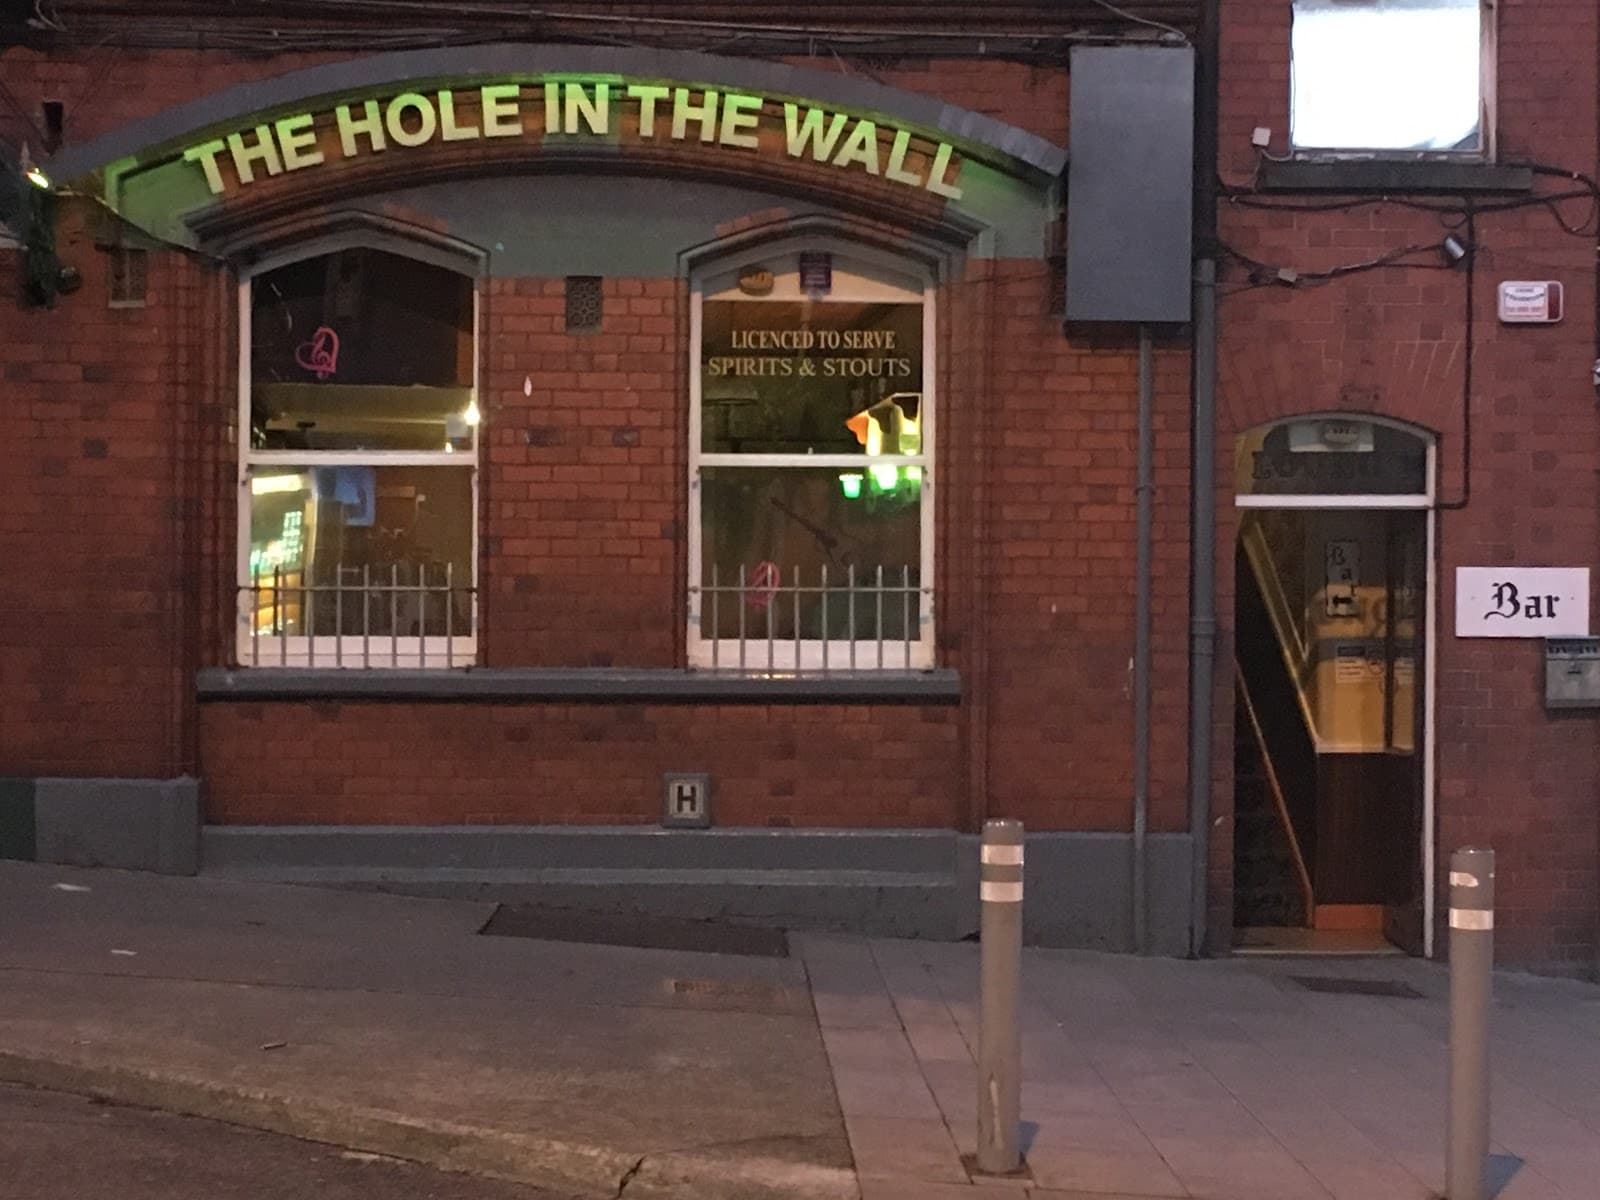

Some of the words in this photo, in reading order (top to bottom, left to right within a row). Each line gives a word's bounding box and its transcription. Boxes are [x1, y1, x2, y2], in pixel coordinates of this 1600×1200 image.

[183, 113, 324, 195] THE
[335, 84, 523, 158] HOLE
[543, 82, 611, 135] IN
[627, 85, 764, 148] THE
[783, 102, 963, 200] WALL
[731, 330, 814, 350] LICENCED
[819, 330, 842, 350] TO
[843, 330, 896, 350] SERVE
[707, 357, 793, 377] SPIRITS
[799, 357, 817, 377] &
[823, 357, 911, 377] STOUTS
[1483, 581, 1561, 620] Bar
[677, 785, 697, 812] H
